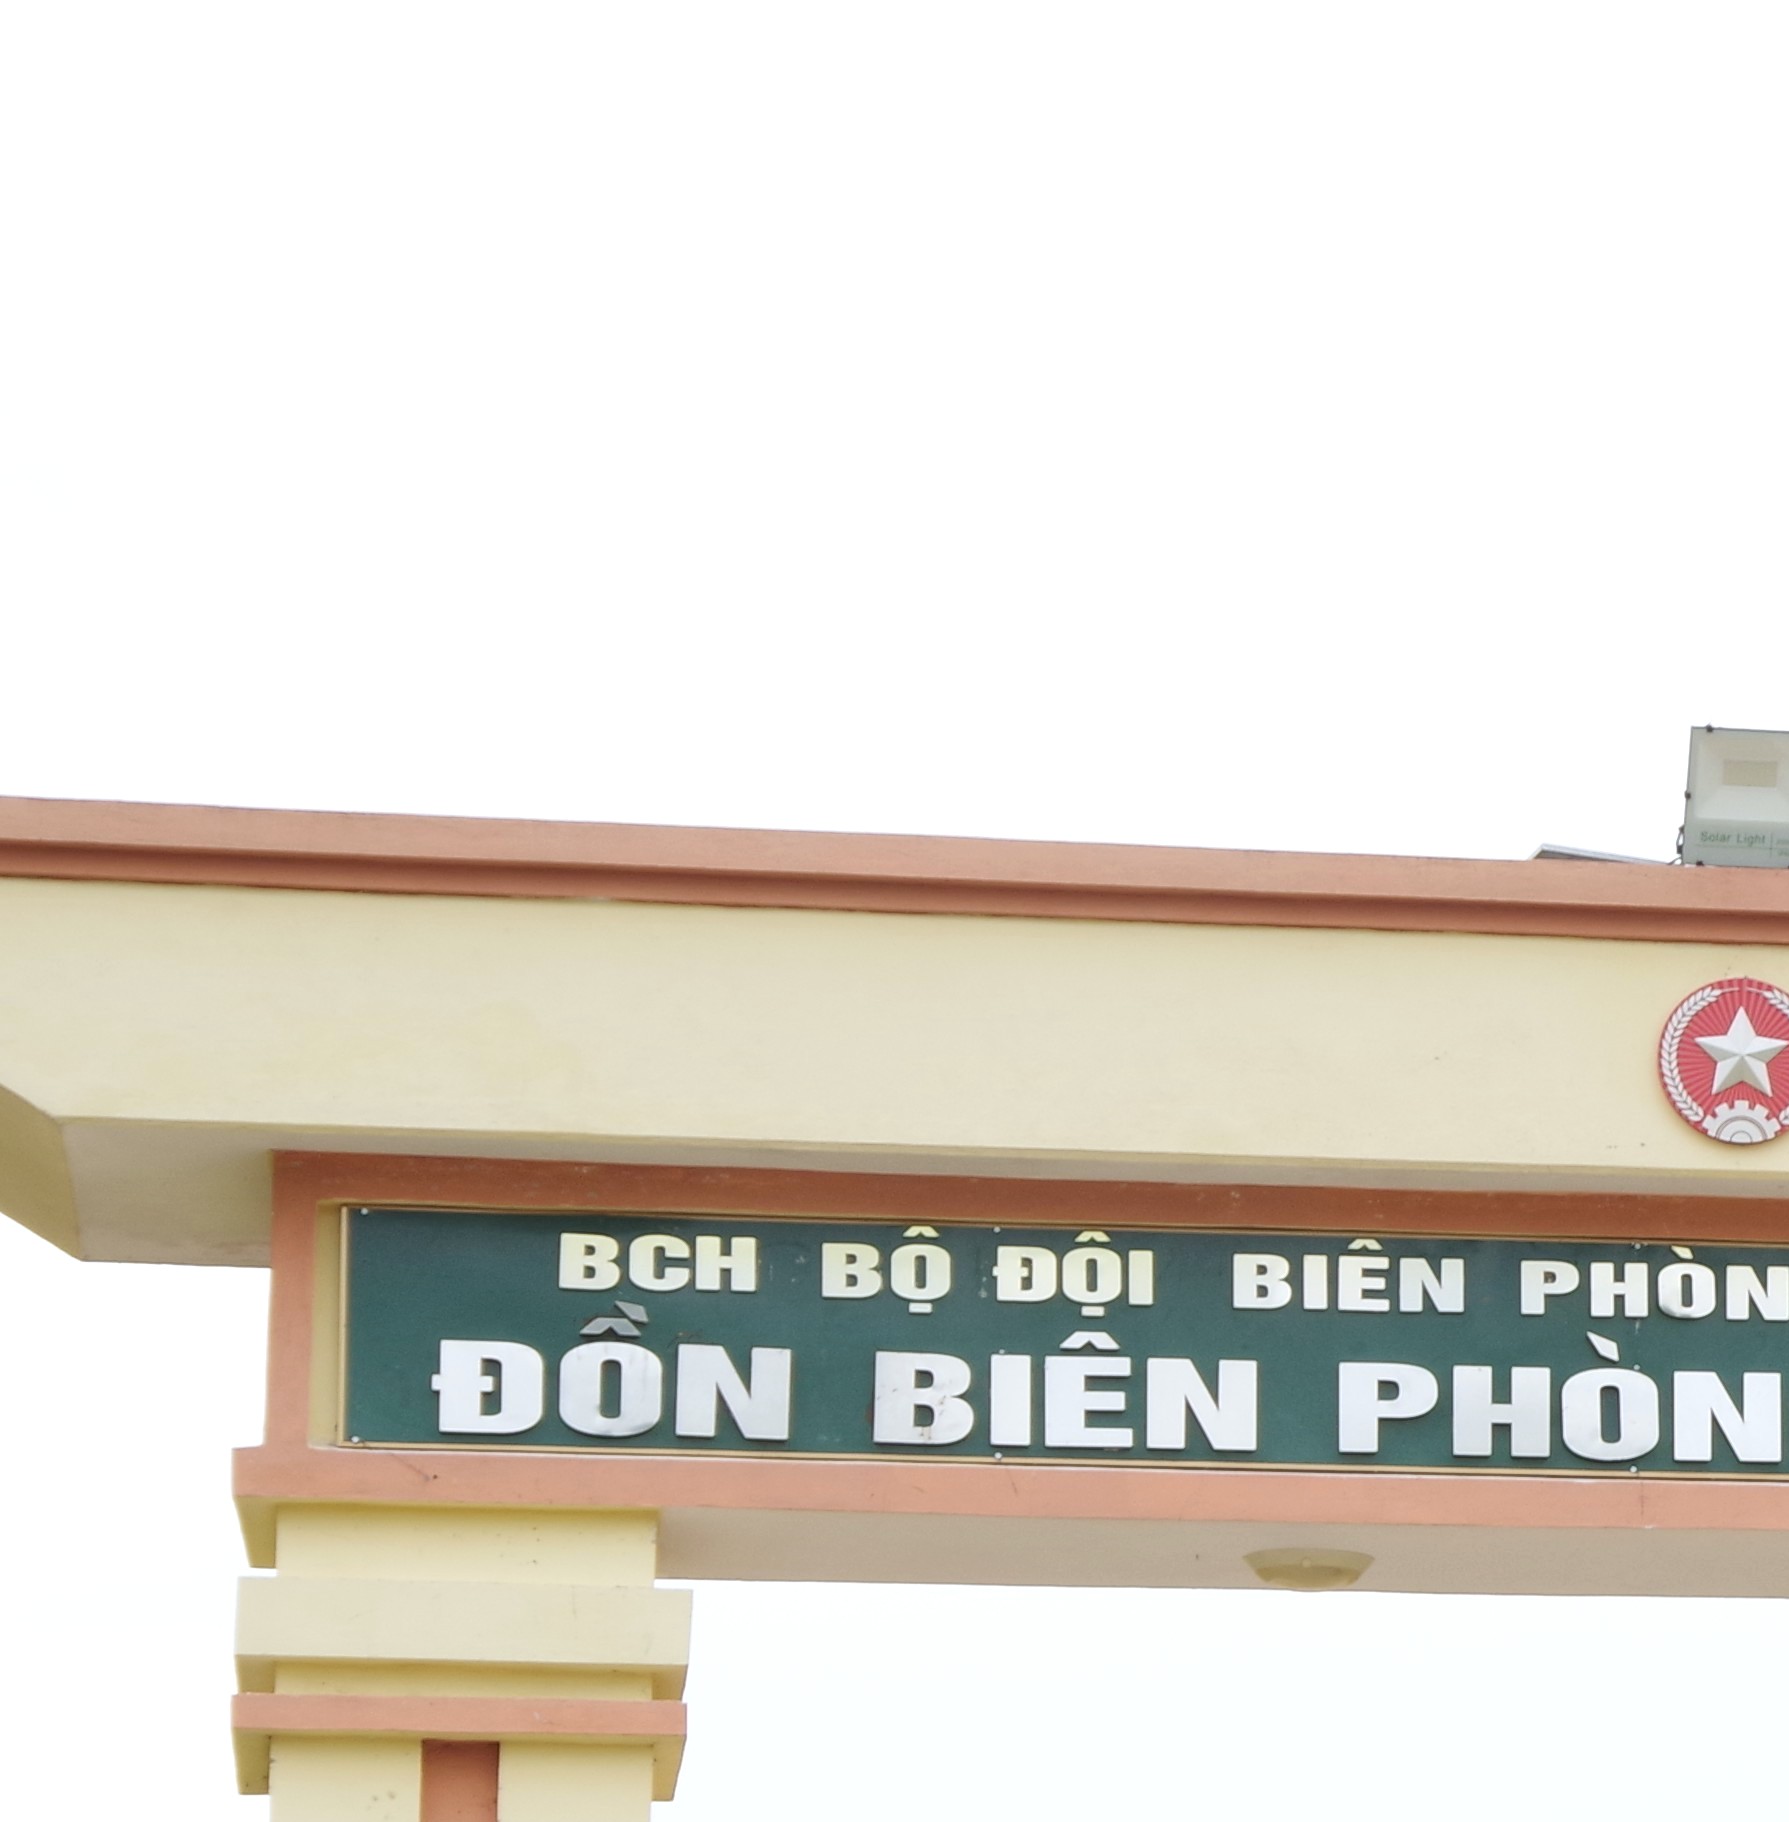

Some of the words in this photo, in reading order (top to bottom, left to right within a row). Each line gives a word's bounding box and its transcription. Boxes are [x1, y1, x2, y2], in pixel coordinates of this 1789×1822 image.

[1700, 831, 1731, 843] Solar
[1736, 832, 1766, 848] Light
[558, 1232, 759, 1292] BCH
[821, 1225, 952, 1314] BỘ
[991, 1230, 1154, 1317] ĐỘI
[1232, 1238, 1465, 1313] BIÊN
[430, 1300, 793, 1441] ĐỒN
[872, 1330, 1258, 1452] BIÊN
